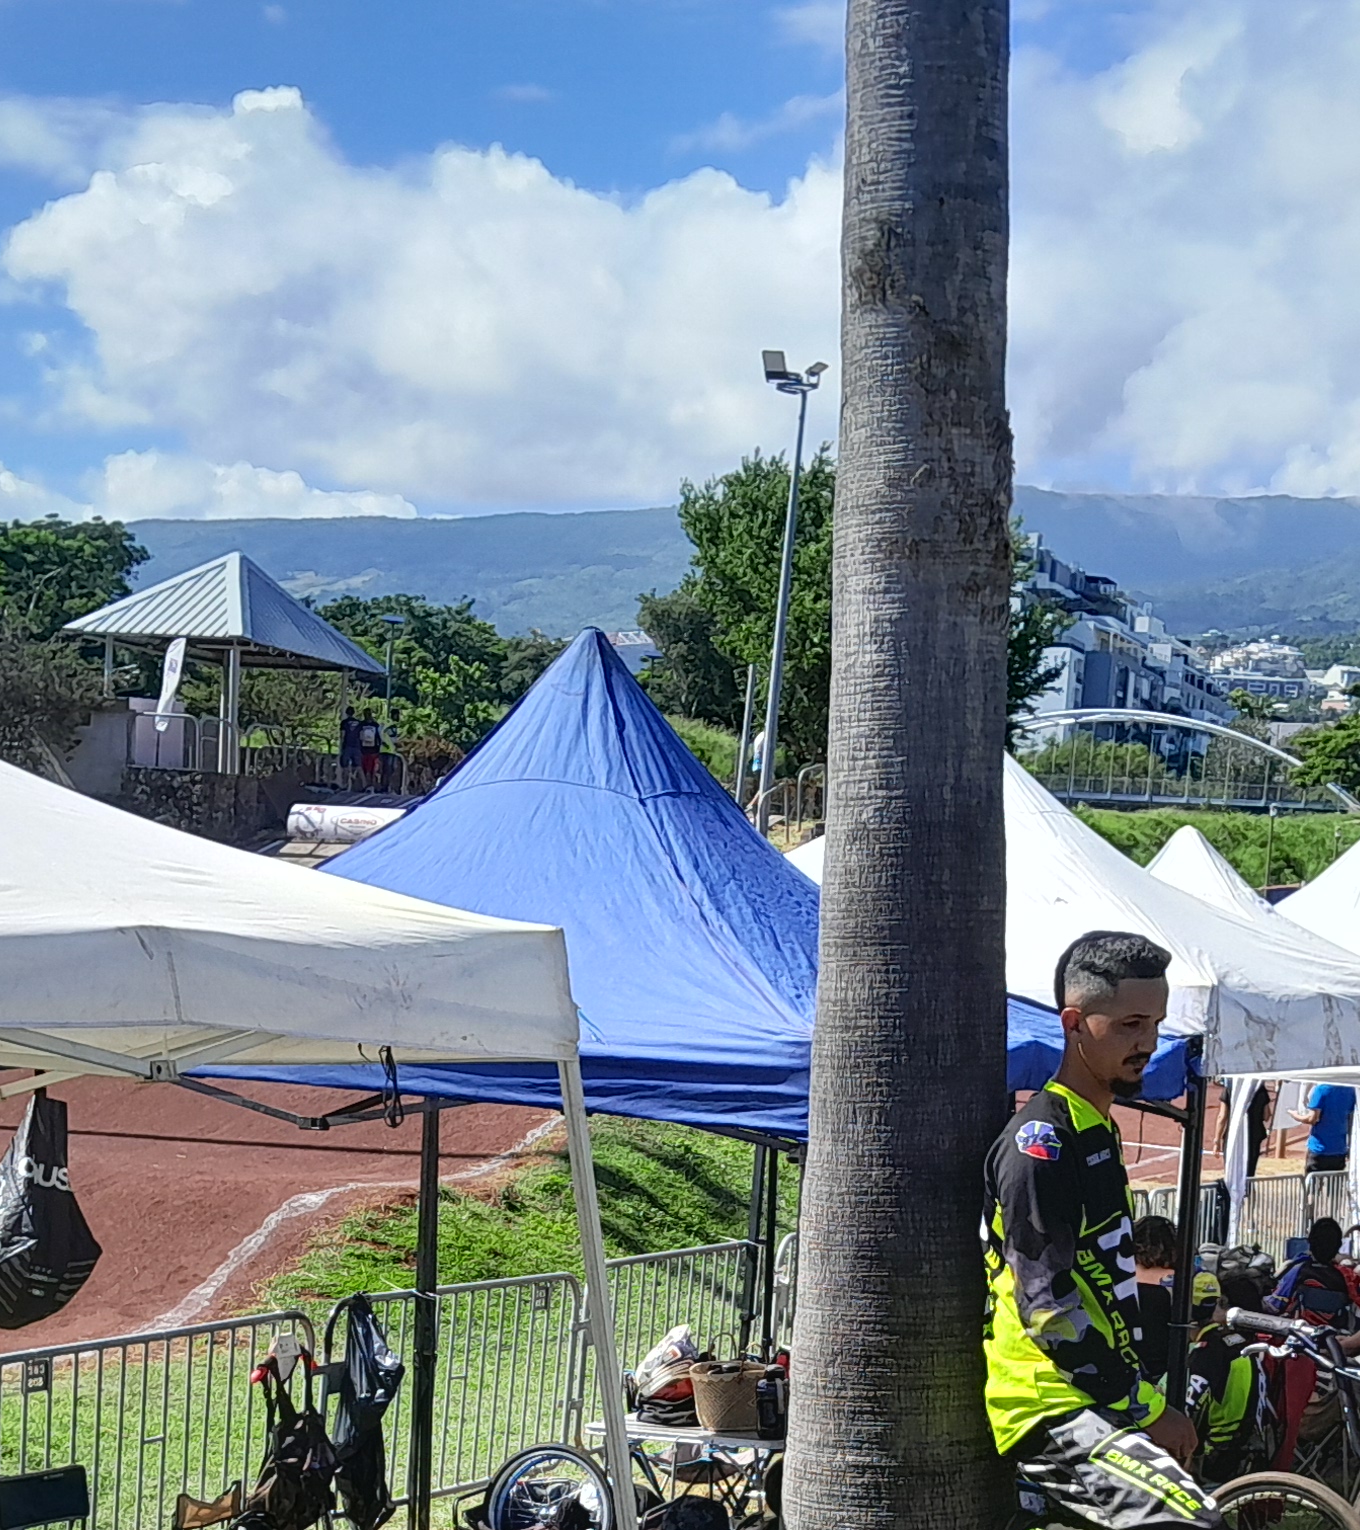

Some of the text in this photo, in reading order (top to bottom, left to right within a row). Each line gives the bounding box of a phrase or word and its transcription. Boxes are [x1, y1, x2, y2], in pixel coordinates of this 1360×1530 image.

[339, 818, 378, 826] CASINO
[1076, 1248, 1114, 1306] BMX
[1110, 1310, 1141, 1371] RAC
[1104, 1448, 1153, 1479] BMX
[1148, 1472, 1202, 1512] RACE
